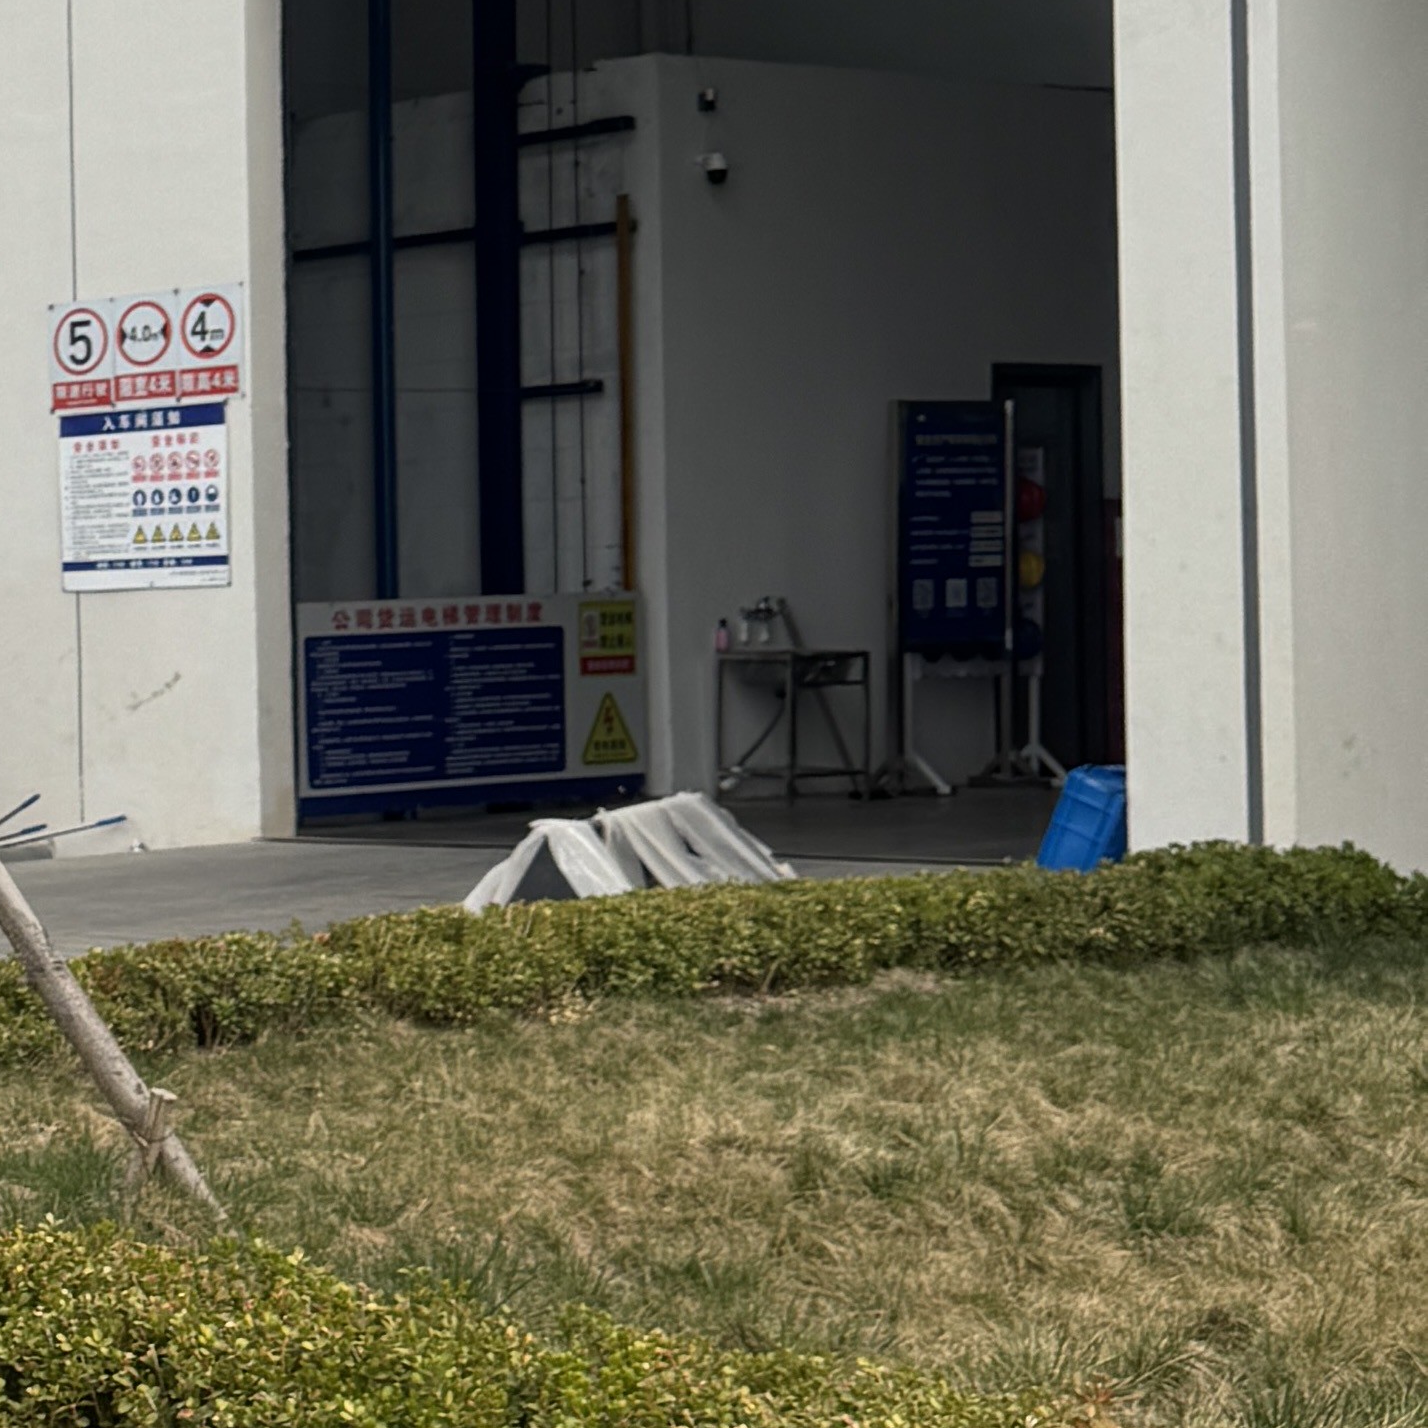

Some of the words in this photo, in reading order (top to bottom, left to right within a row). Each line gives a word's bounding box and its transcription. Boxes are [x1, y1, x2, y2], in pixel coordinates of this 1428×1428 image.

[69, 320, 92, 365] 5
[332, 602, 543, 630] 公司货运电梯管理制度
